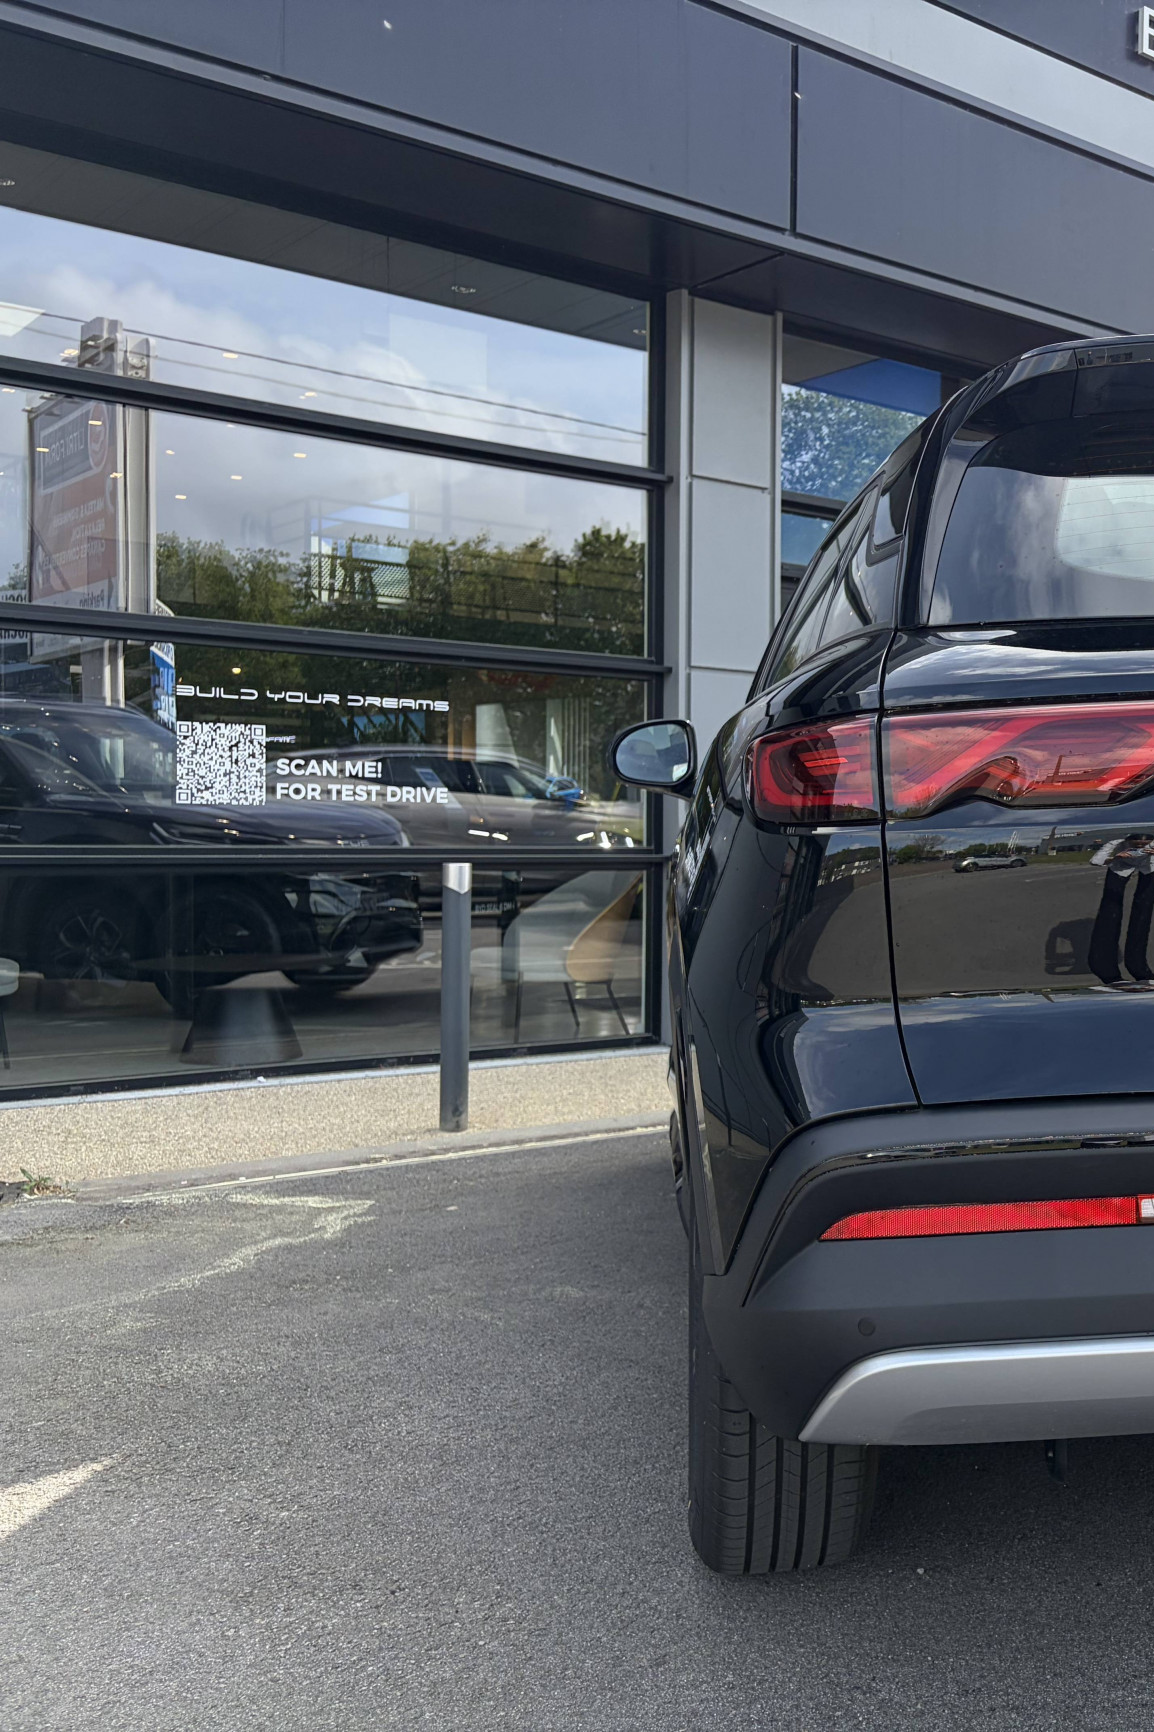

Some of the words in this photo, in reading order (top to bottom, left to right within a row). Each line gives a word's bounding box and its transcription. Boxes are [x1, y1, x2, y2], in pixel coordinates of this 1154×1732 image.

[176, 685, 259, 701] BUILD
[266, 690, 340, 705] YOUR
[347, 695, 450, 712] DREAMS
[276, 758, 338, 778] SCAN
[346, 760, 383, 779] ME!
[276, 783, 322, 801] FOR
[327, 784, 381, 802] TEST
[386, 786, 450, 804] DRIVE
